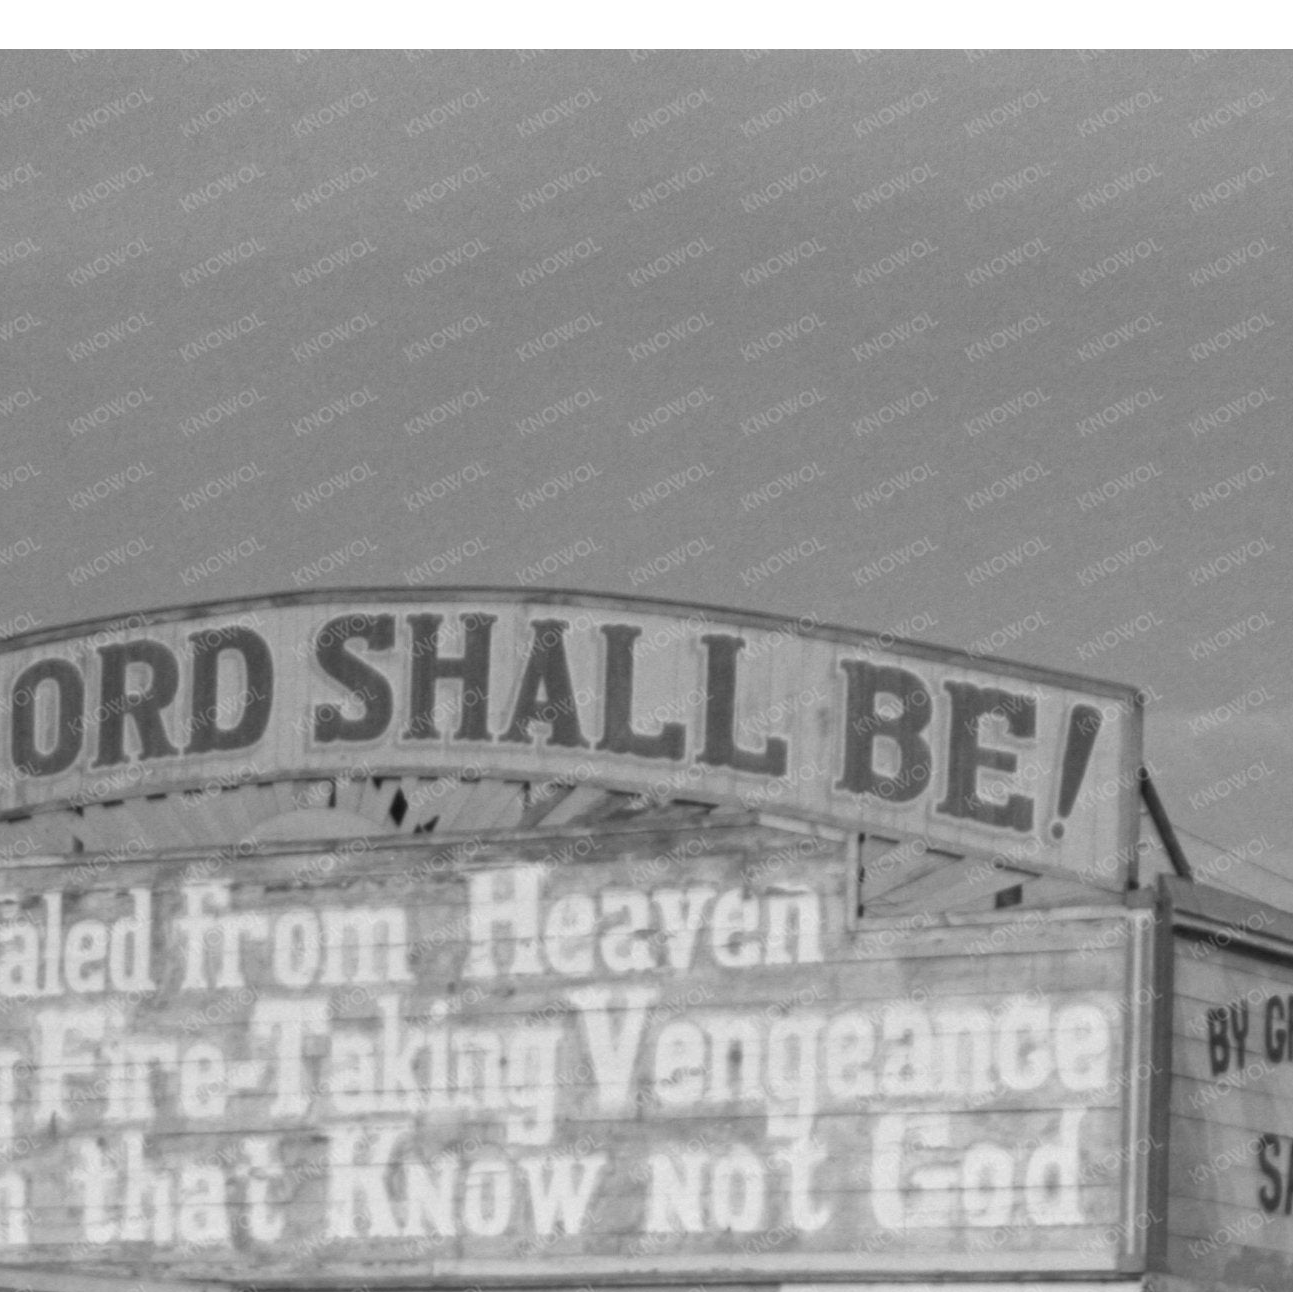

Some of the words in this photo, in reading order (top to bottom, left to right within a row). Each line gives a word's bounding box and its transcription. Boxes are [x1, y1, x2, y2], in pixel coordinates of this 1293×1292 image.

[315, 613, 789, 777] SHALL
[837, 658, 1102, 840] BE!
[173, 879, 414, 990] from
[464, 864, 824, 977] Heaven
[573, 985, 1110, 1138] Vengeance
[1206, 998, 1249, 1078] BY
[73, 1130, 285, 1241] that
[870, 1107, 1088, 1230] God
